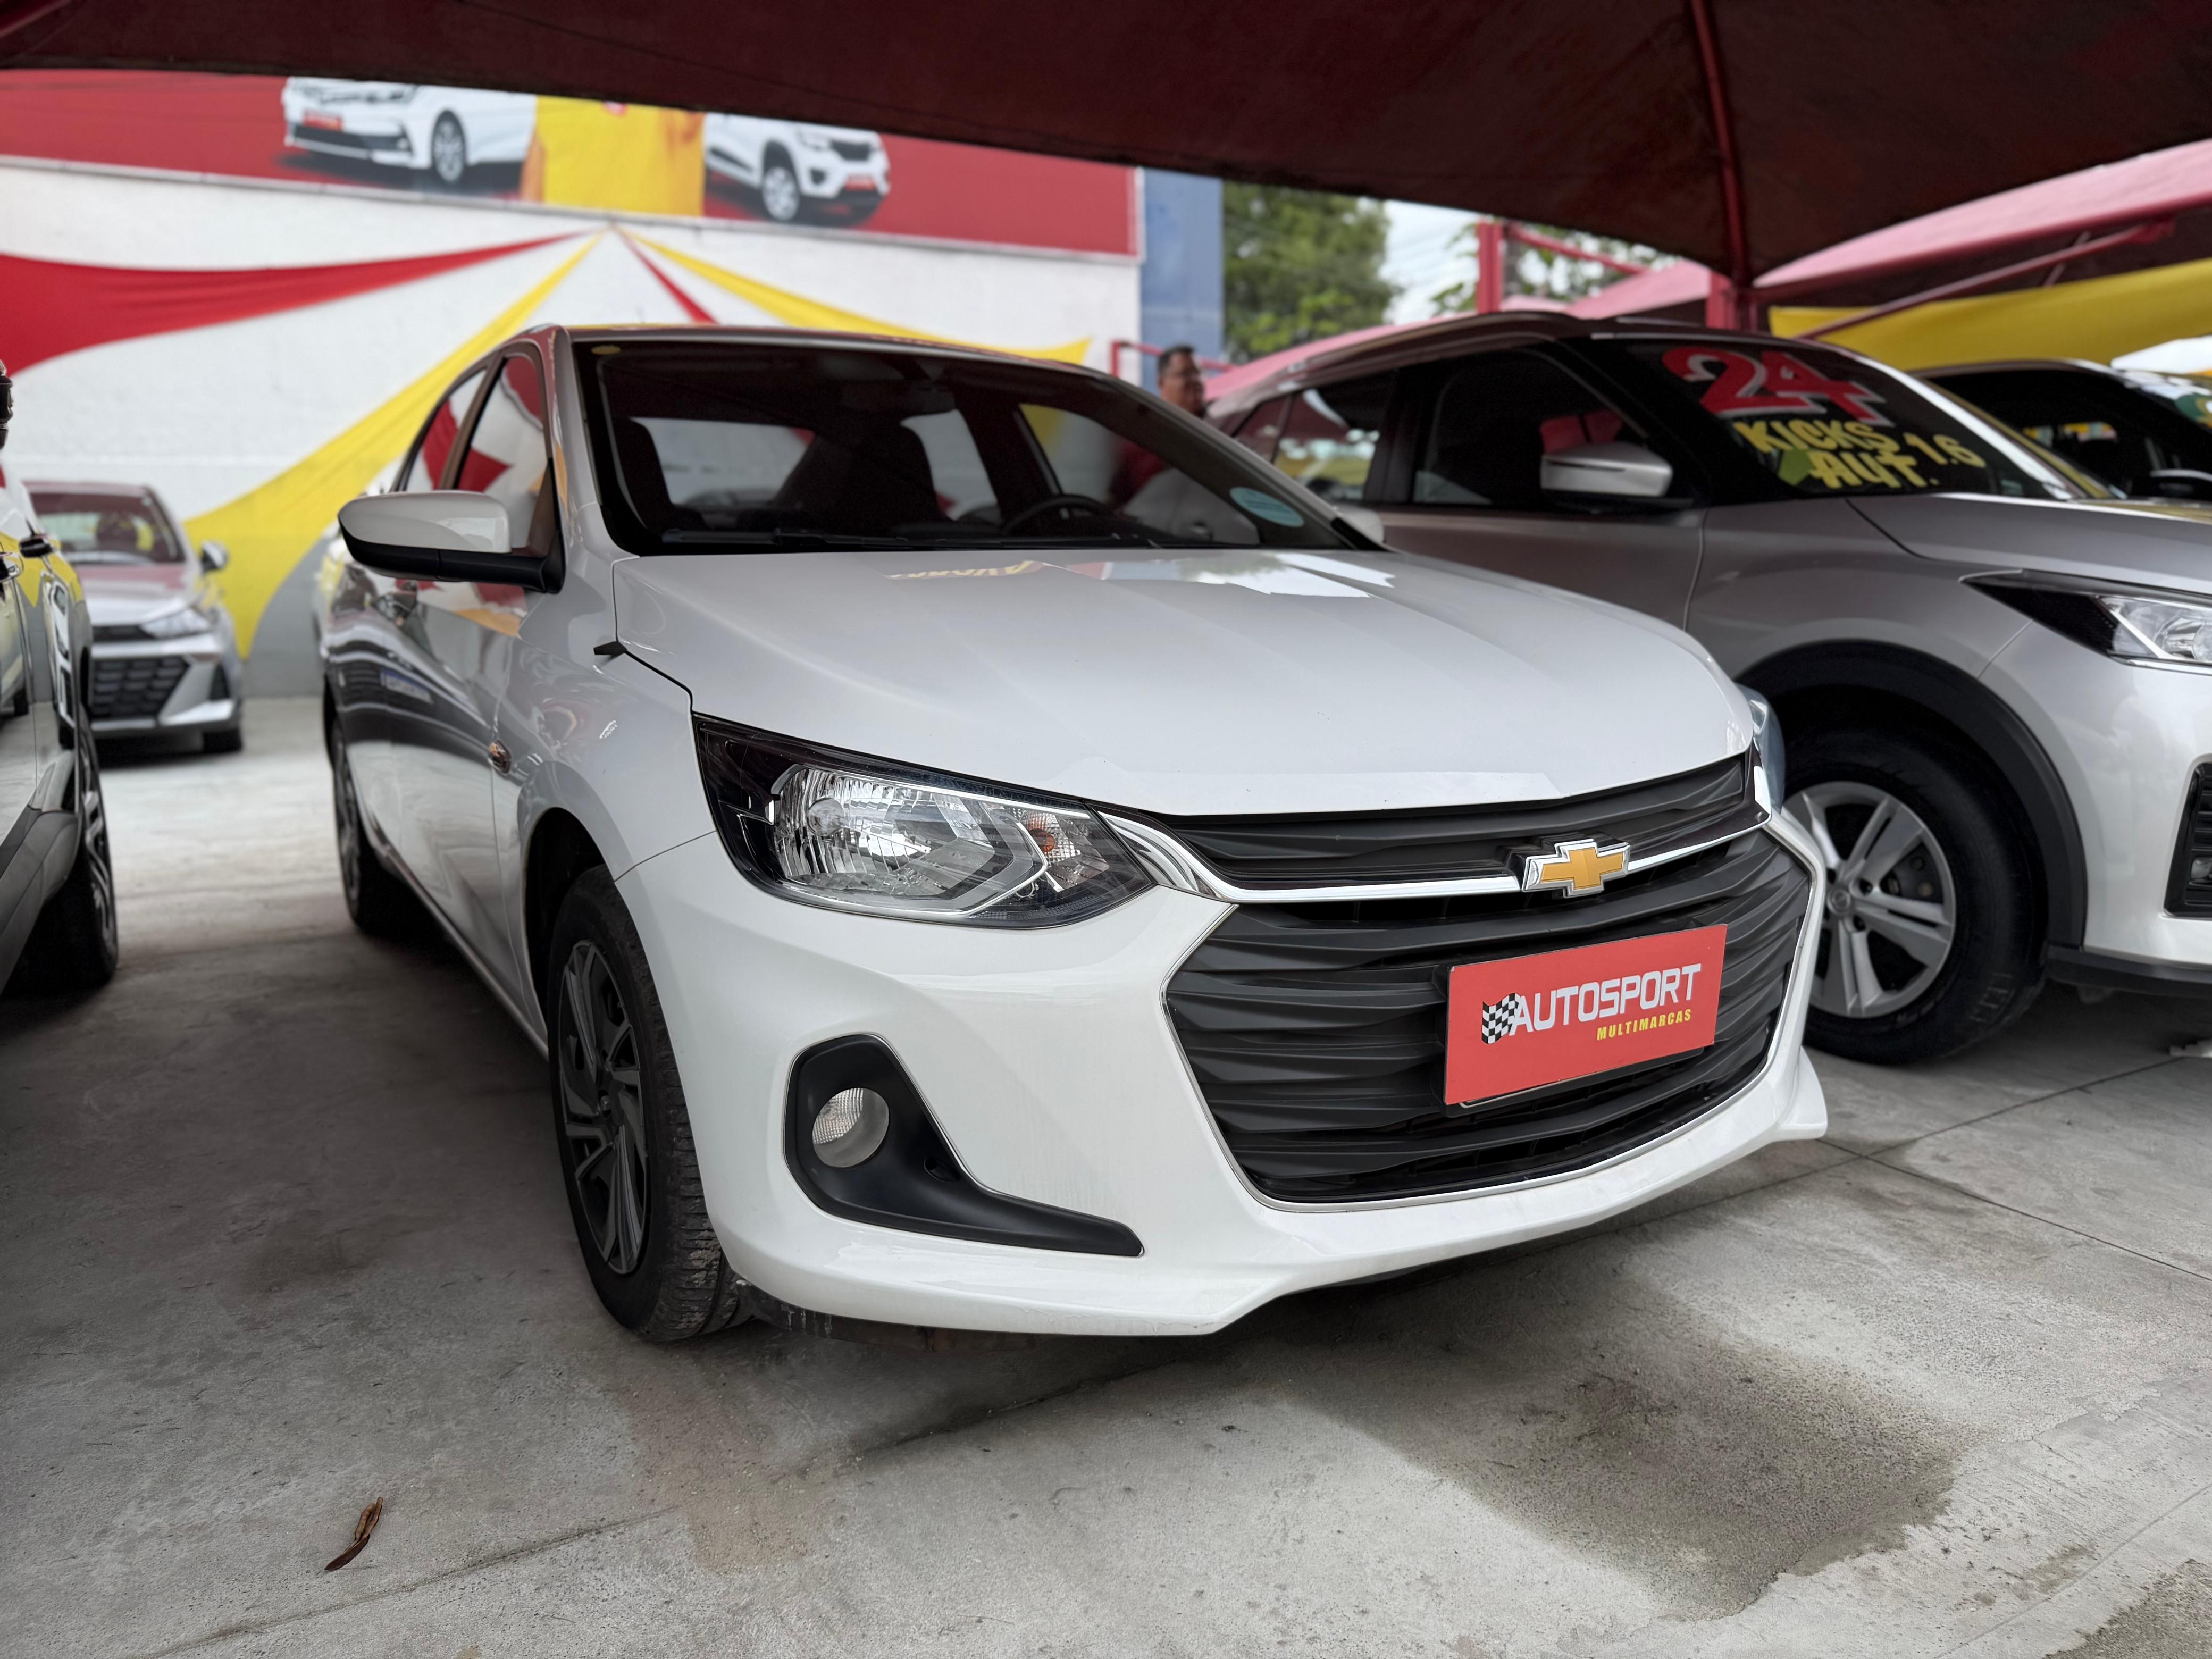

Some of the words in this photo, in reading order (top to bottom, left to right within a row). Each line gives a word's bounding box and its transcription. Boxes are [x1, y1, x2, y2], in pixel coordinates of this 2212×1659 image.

[1663, 347, 1895, 426] 24
[1733, 420, 1900, 453] KICKS
[1903, 432, 1987, 468] 1.6
[1509, 963, 1702, 1036] AUTOSPORT
[1596, 1009, 1692, 1041] MULTIMARCAS
